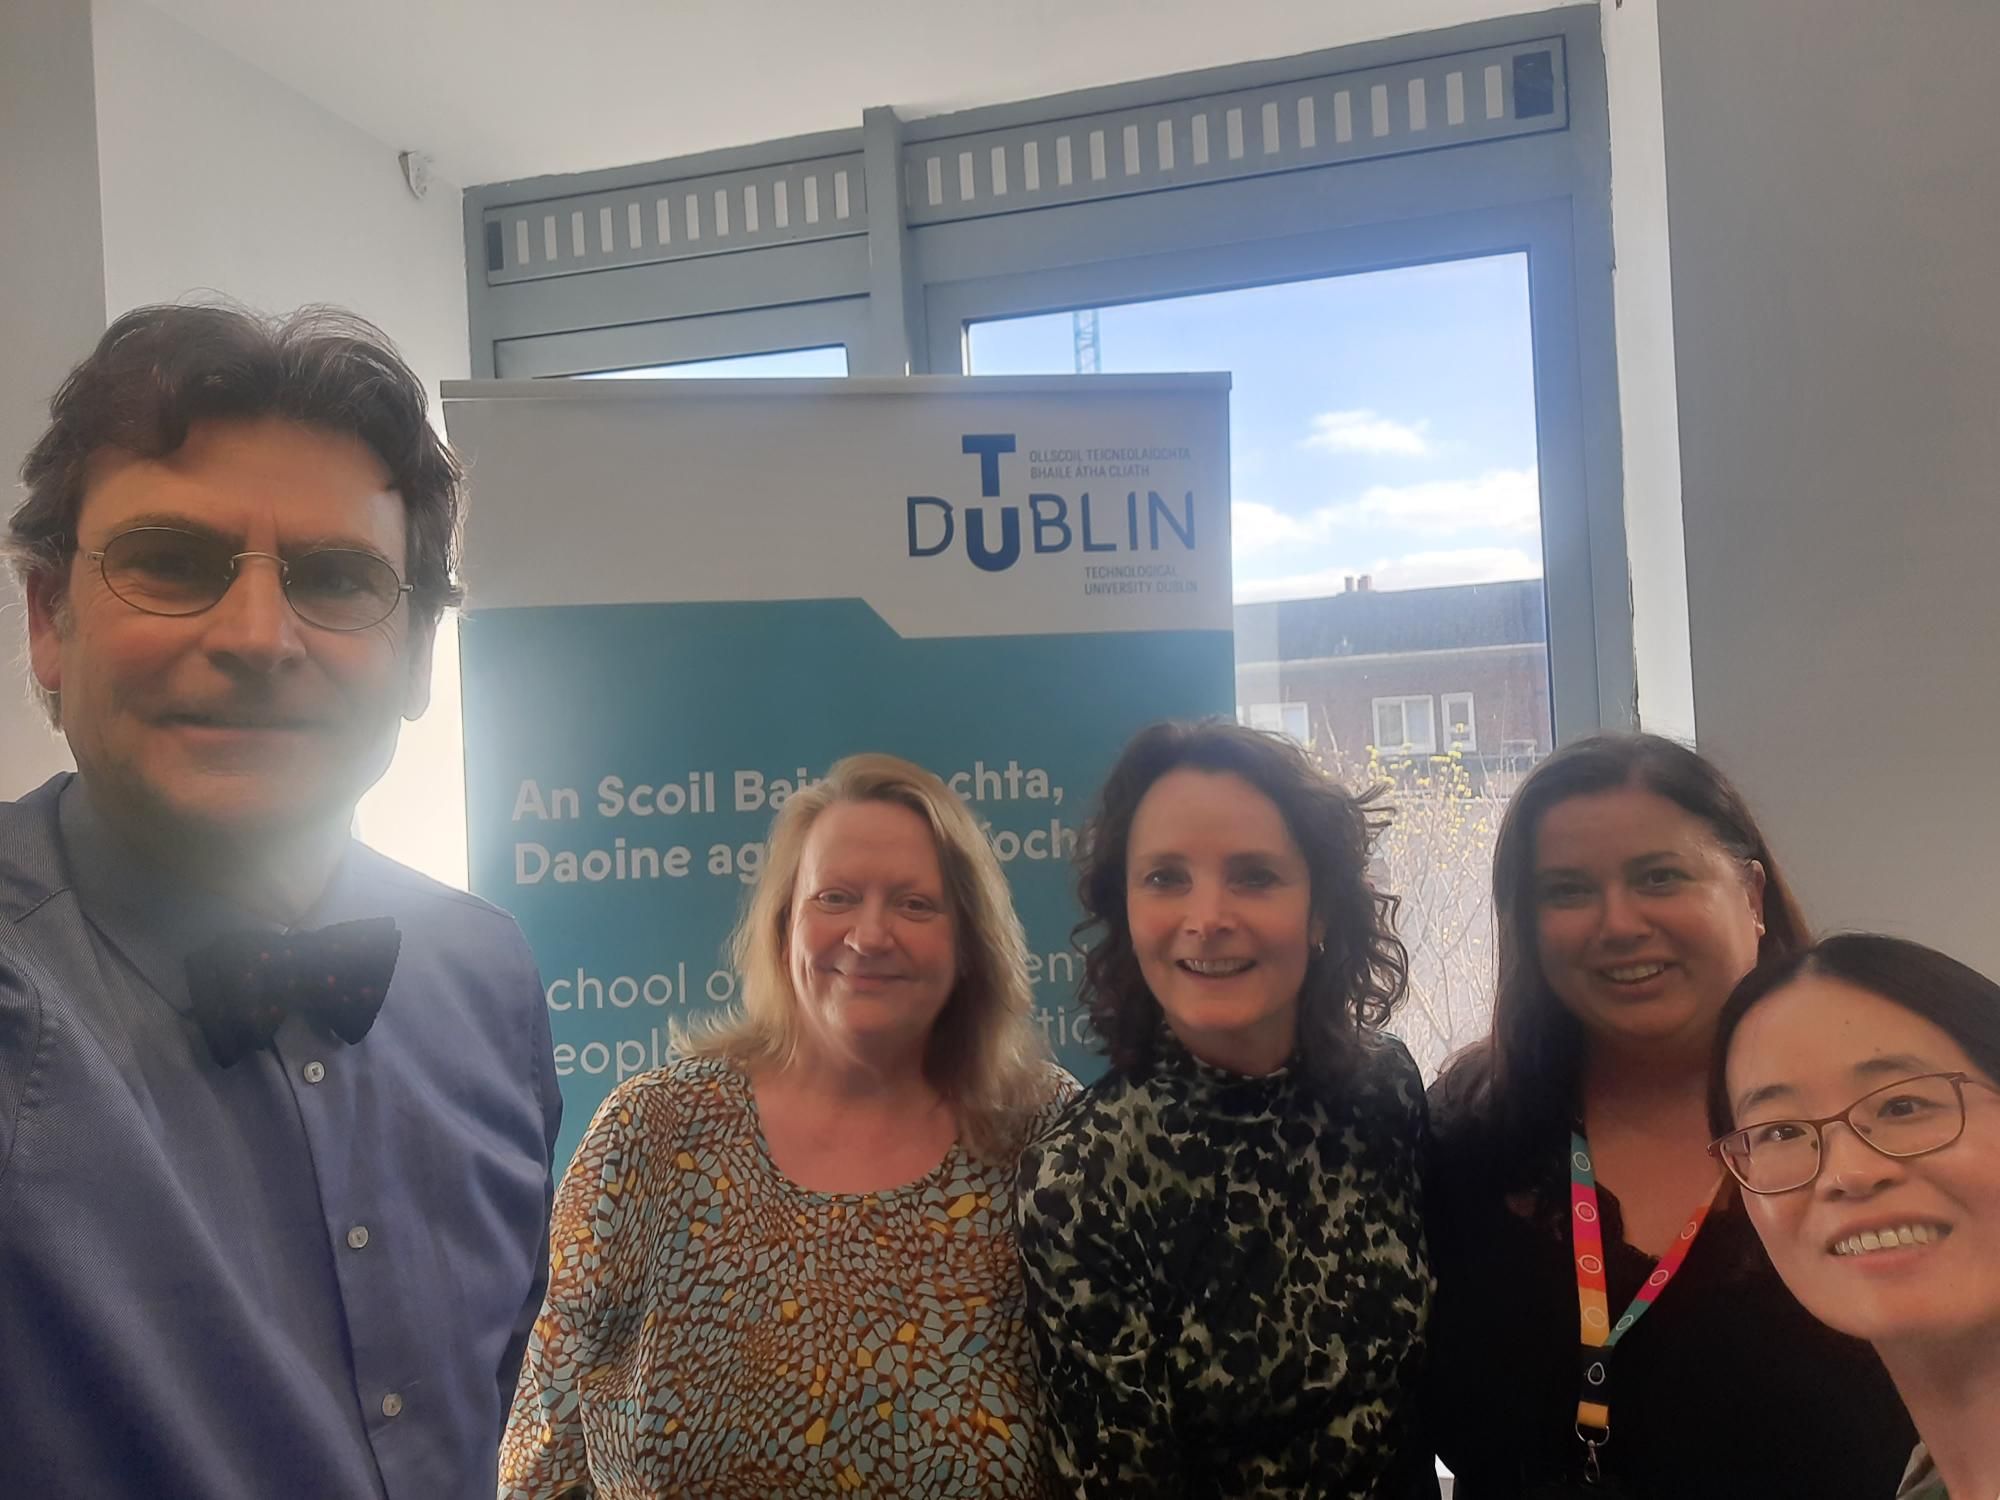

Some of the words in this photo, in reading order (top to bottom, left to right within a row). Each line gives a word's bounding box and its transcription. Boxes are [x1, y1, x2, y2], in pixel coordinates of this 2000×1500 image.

[1029, 449, 1083, 463] OLLSCOIL
[1030, 466, 1073, 479] BHAILE
[1108, 464, 1150, 478] CLIATH
[1084, 565, 1177, 579] TECHNOLOGICAL
[1084, 581, 1152, 596] UNIVERSITY
[1155, 580, 1198, 593] DUBLIN
[511, 778, 580, 821] An
[597, 771, 715, 817] Scoil
[515, 838, 691, 885] Daoine
[546, 962, 686, 1012] chool
[553, 1027, 686, 1083] eopl
